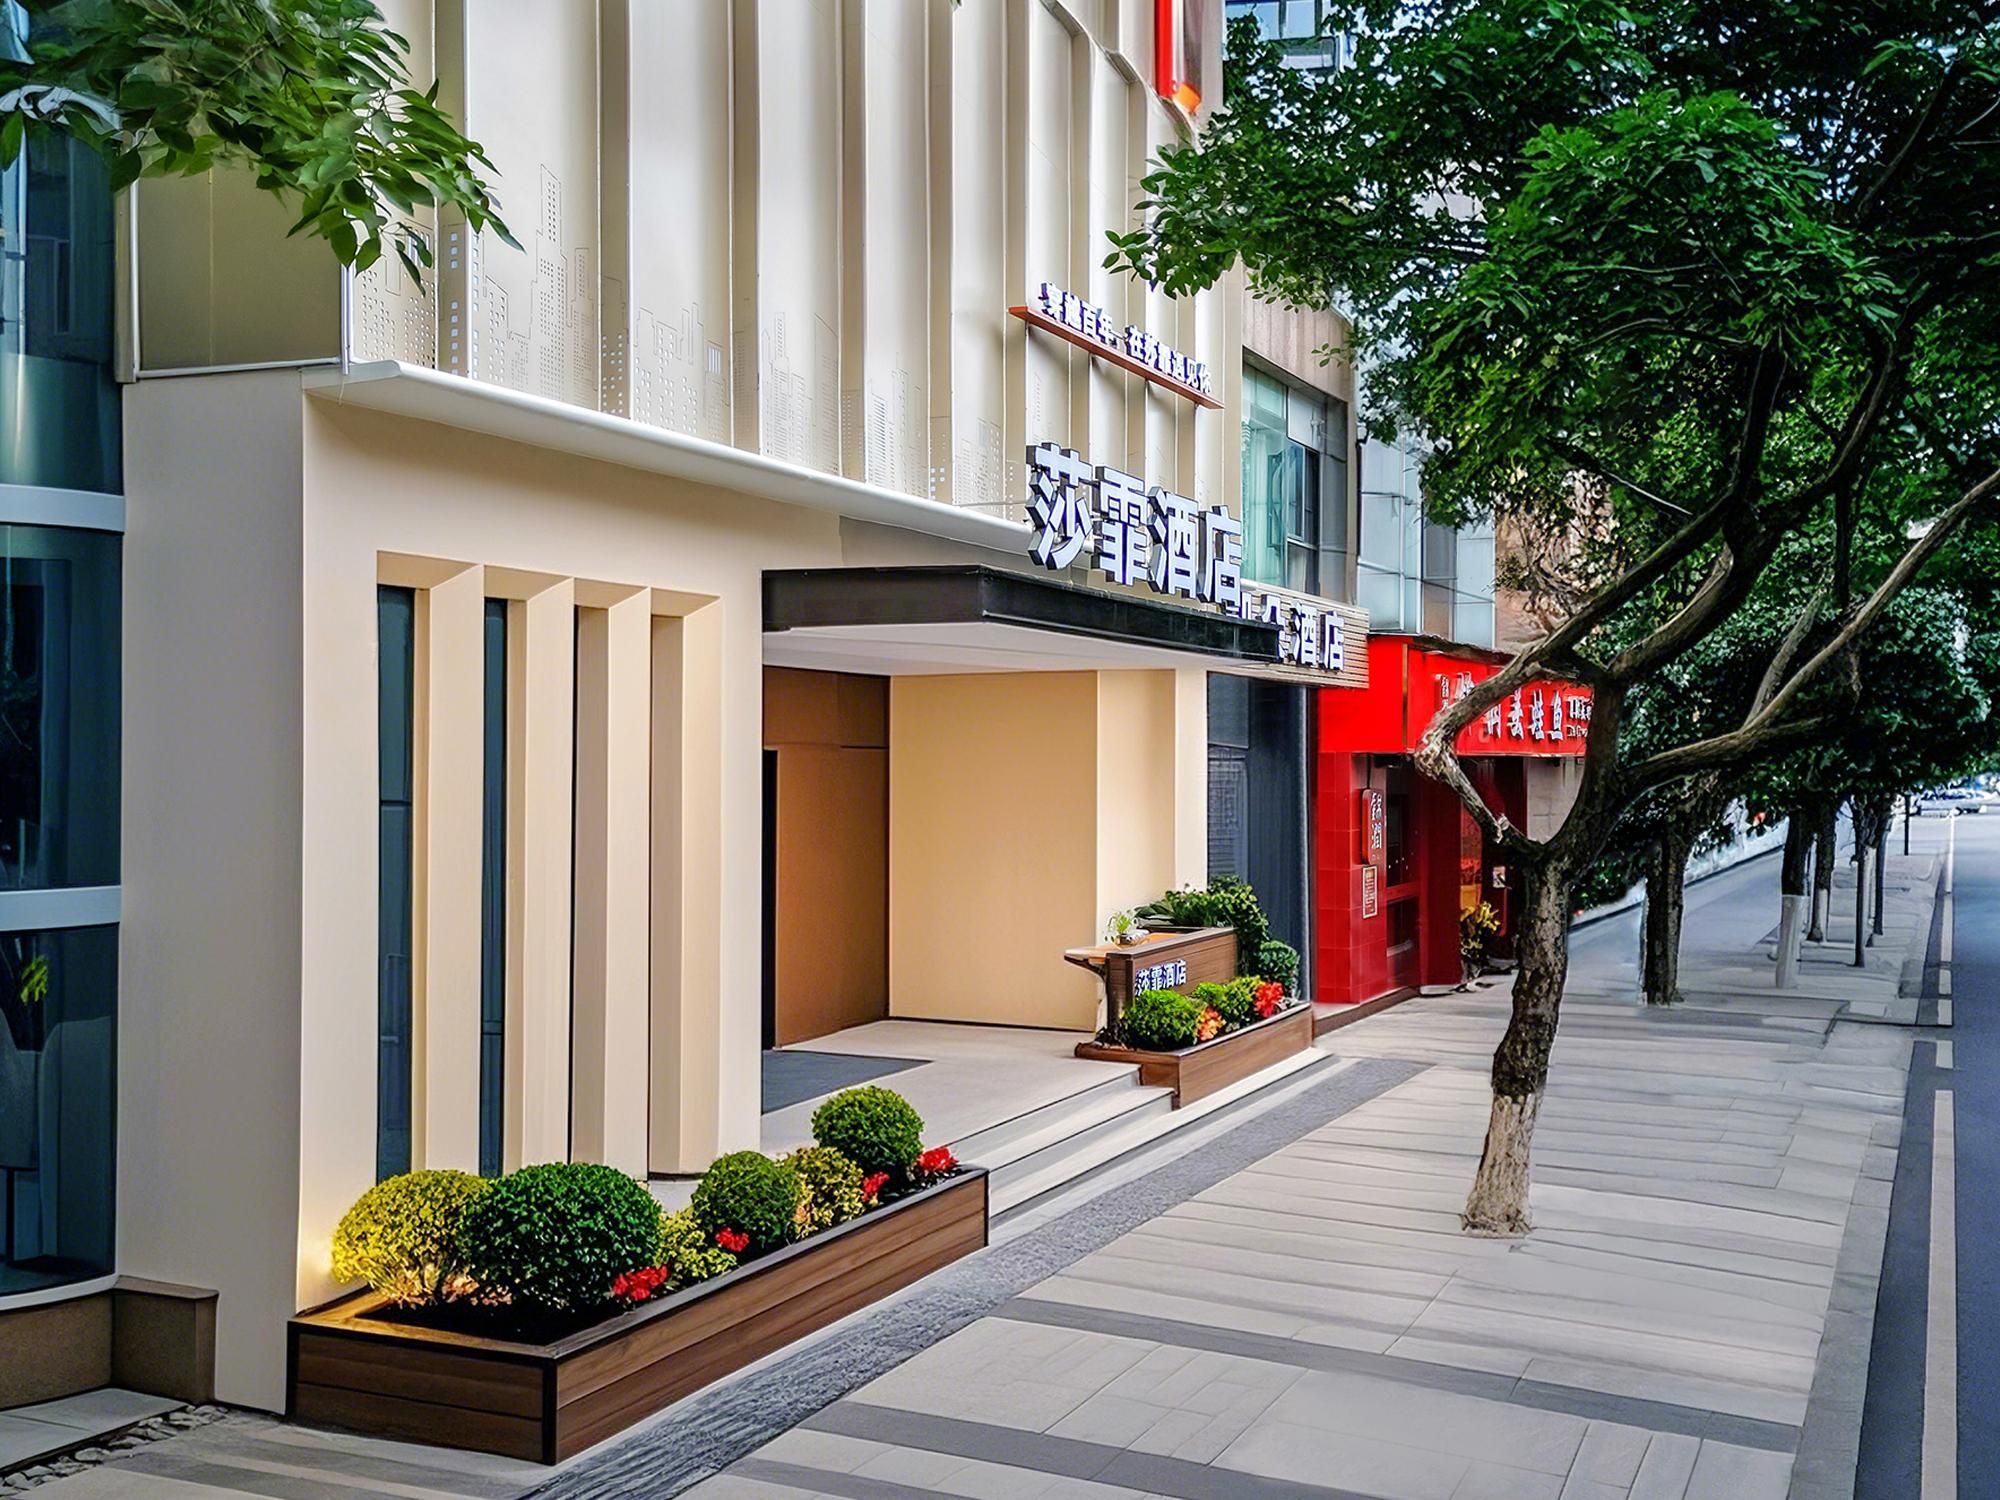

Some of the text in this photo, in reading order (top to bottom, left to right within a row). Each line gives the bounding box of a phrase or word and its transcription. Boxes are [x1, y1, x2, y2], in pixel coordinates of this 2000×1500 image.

[1026, 442, 1242, 606] 莎霏酒店
[1134, 959, 1187, 997] 莎霏酒店
